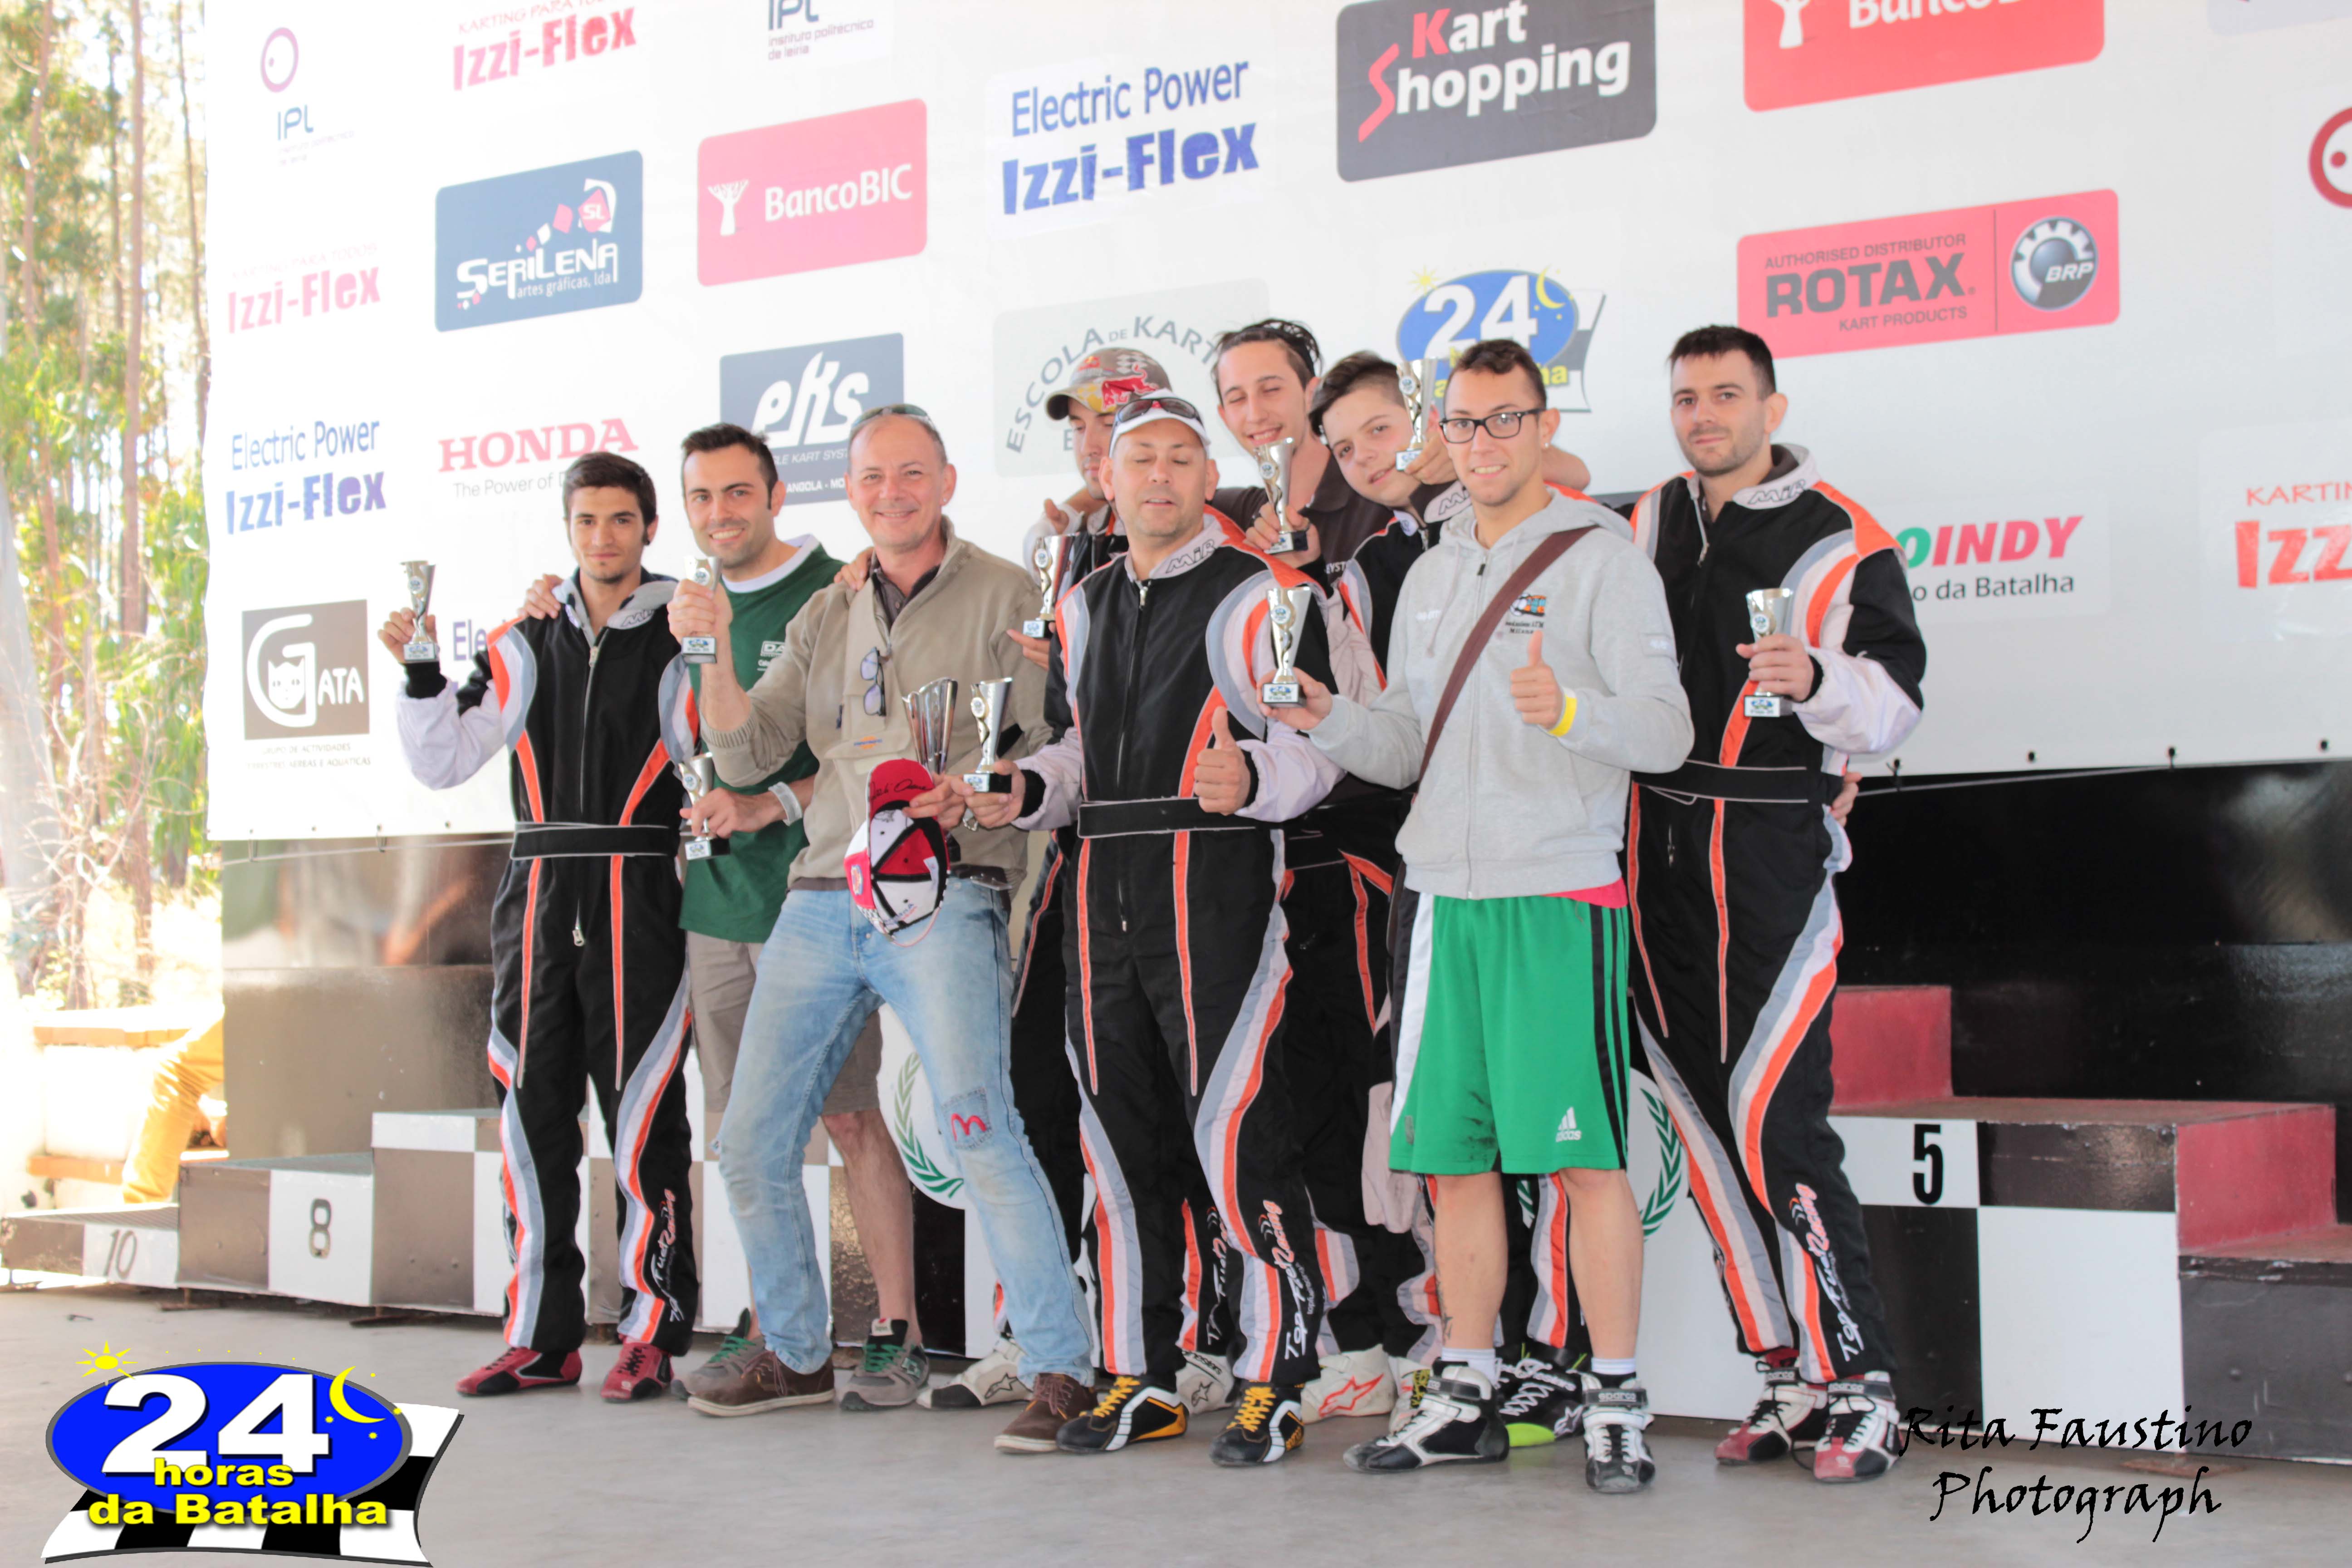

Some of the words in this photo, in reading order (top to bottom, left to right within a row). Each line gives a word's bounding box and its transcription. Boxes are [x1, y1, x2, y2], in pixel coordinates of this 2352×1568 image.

[453, 7, 636, 91] Izzi-Flex
[768, 29, 811, 47] instituto
[814, 19, 874, 42] politécnico
[768, 47, 781, 61] de
[784, 44, 809, 58] leiria
[1412, 0, 1528, 58] Kart
[1011, 74, 1132, 137] Electric
[1143, 60, 1250, 114] Power
[1358, 26, 1631, 143] Shopping
[277, 103, 314, 141] IPL
[765, 164, 912, 221] BancoBIC
[1002, 122, 1259, 216] Izzi-Flex
[583, 204, 605, 220] SL
[1764, 246, 1860, 269] AUTHORISED
[1864, 233, 1967, 258] DISTRIBUTOR
[2045, 262, 2094, 282] BRP
[228, 266, 381, 334] Izzi-Flex
[517, 282, 543, 298] artes
[1765, 252, 1966, 318] ROTAX
[1423, 274, 1538, 359] 24
[1839, 315, 1879, 333] KART
[1882, 306, 1968, 328] PRODUCTS
[1006, 327, 1105, 454] ESCOLA
[1108, 328, 1128, 343] DE
[232, 425, 306, 471] Electric
[314, 420, 381, 459] Power
[437, 417, 639, 473] HONDA
[225, 471, 387, 535] Izzi-Flex
[453, 481, 480, 498] The
[485, 478, 534, 495] Power
[537, 471, 554, 490] of
[1936, 579, 1967, 601] da
[1975, 571, 2075, 598] Batalha
[1912, 1123, 1944, 1205] 5
[104, 1230, 137, 1279] 10
[309, 1198, 332, 1259] 8
